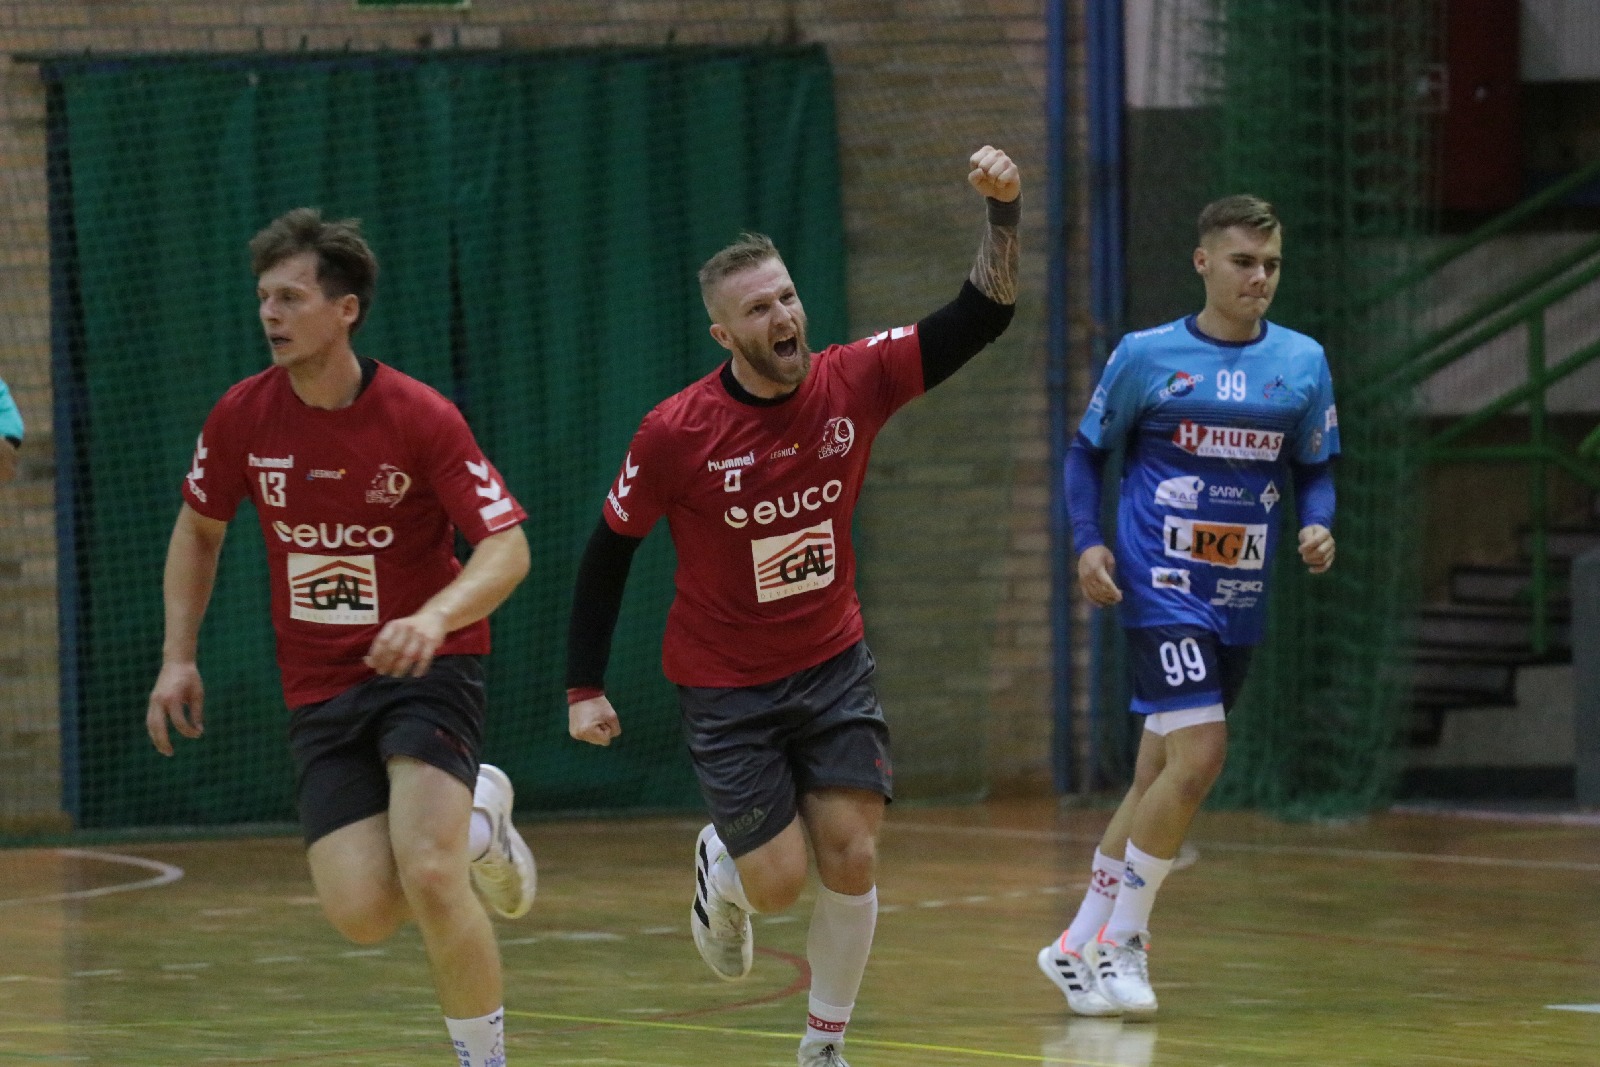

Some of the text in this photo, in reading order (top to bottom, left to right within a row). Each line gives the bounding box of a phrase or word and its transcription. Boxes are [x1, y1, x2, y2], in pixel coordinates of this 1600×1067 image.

[1216, 368, 1247, 401] 99
[1180, 423, 1199, 447] H
[1212, 429, 1281, 450] HURAS
[707, 451, 755, 472] hummel
[769, 446, 797, 460] LEGNICA
[258, 471, 287, 508] 13
[753, 479, 842, 525] euco
[1209, 485, 1244, 499] SARIV
[292, 522, 394, 549] euco
[1168, 526, 1264, 561] LPGK
[779, 544, 834, 585] GAL
[310, 573, 375, 611] GAL
[1159, 637, 1207, 687] 99
